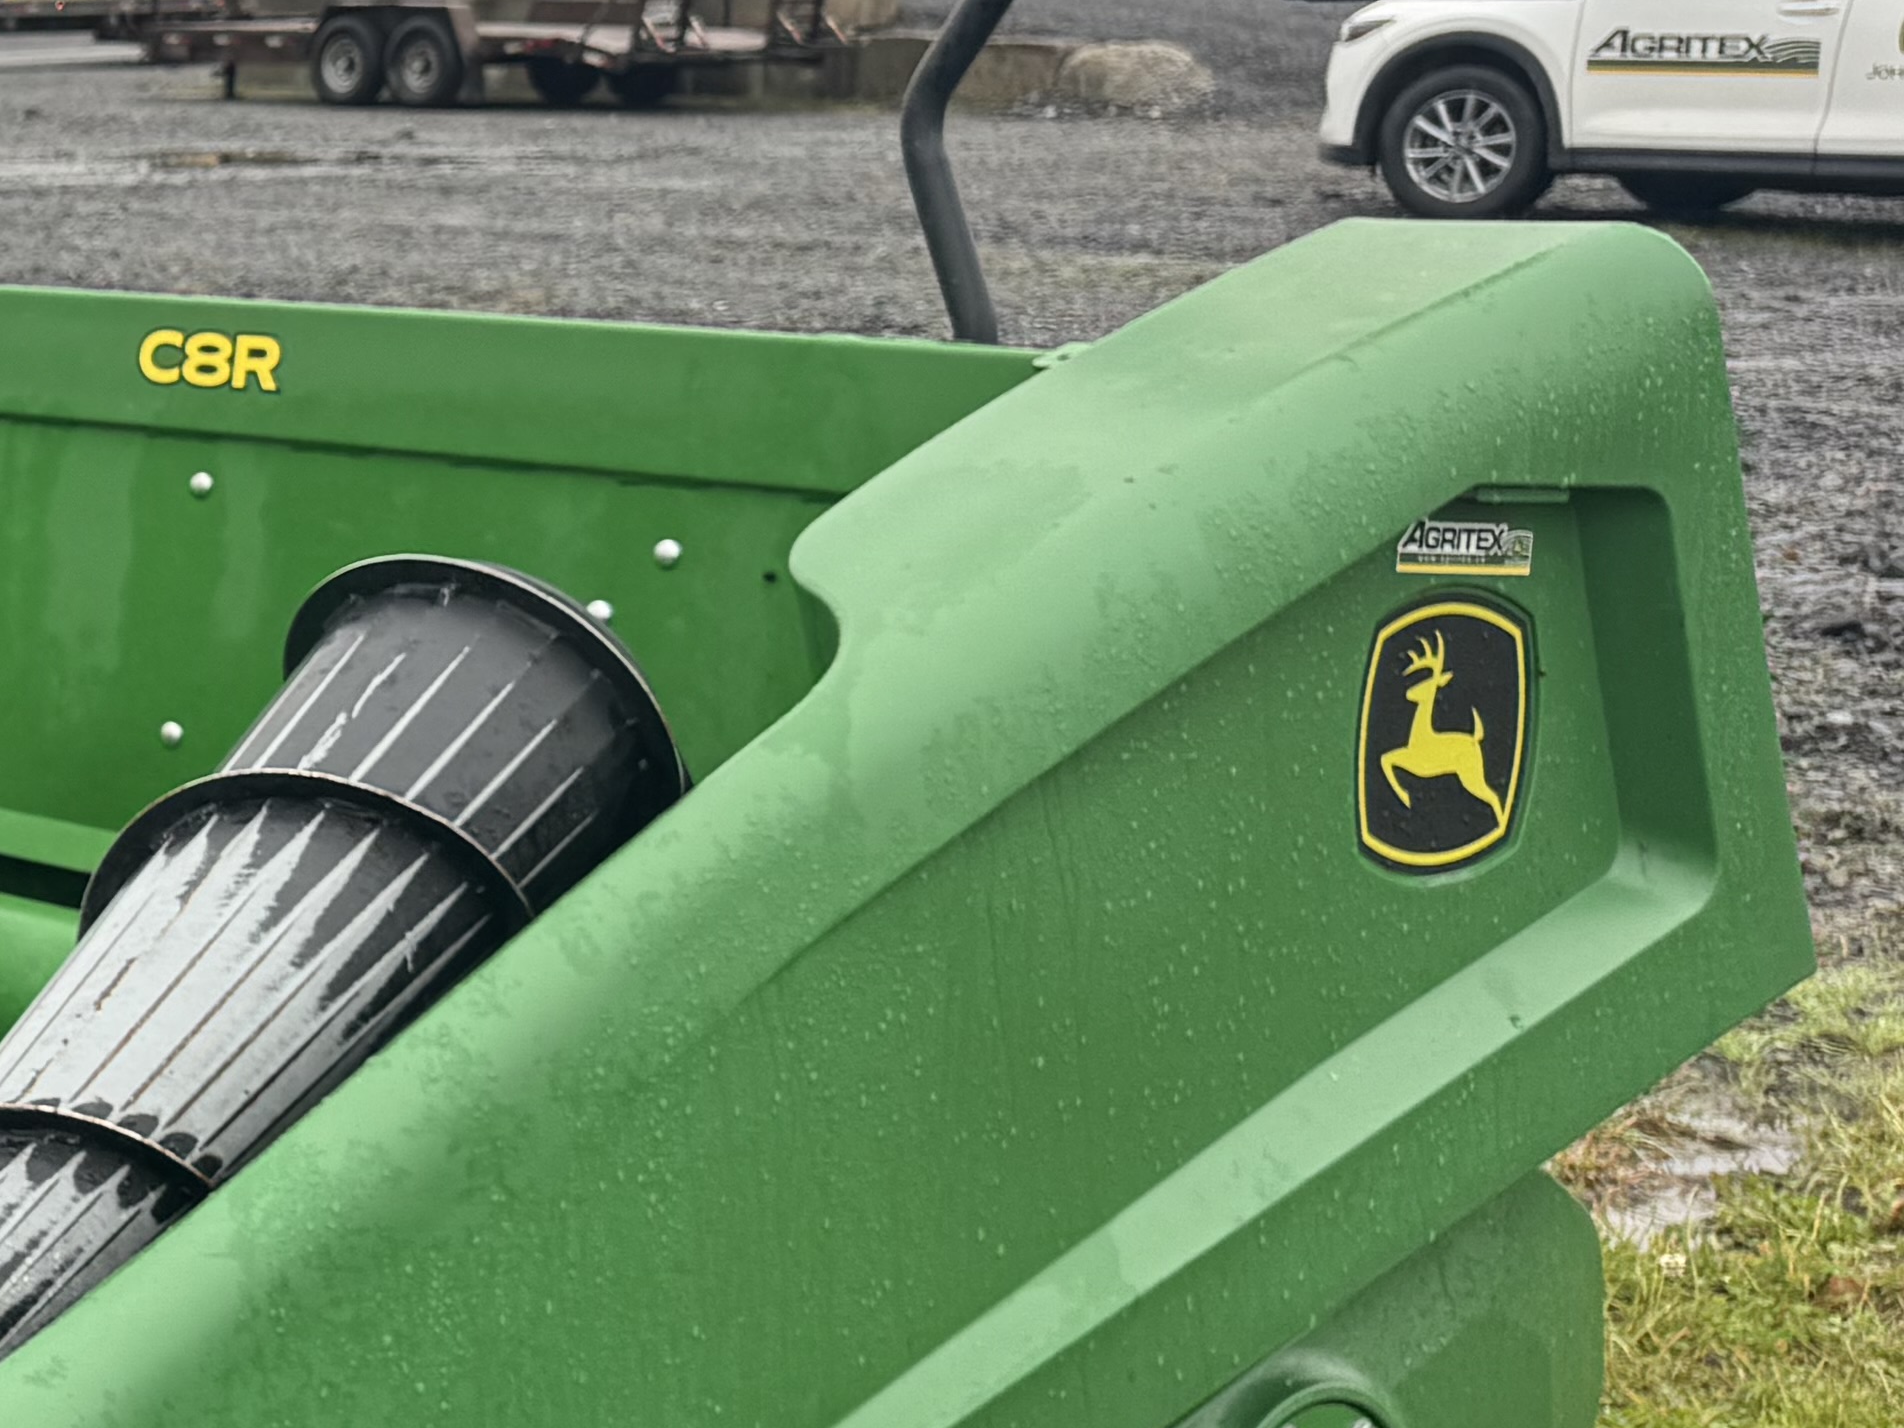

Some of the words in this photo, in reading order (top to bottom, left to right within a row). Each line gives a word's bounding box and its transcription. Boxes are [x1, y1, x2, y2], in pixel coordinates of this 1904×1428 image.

[1593, 29, 1769, 59] AGRITEX
[138, 328, 281, 392] C8R
[1401, 521, 1506, 552] AGRITEX
